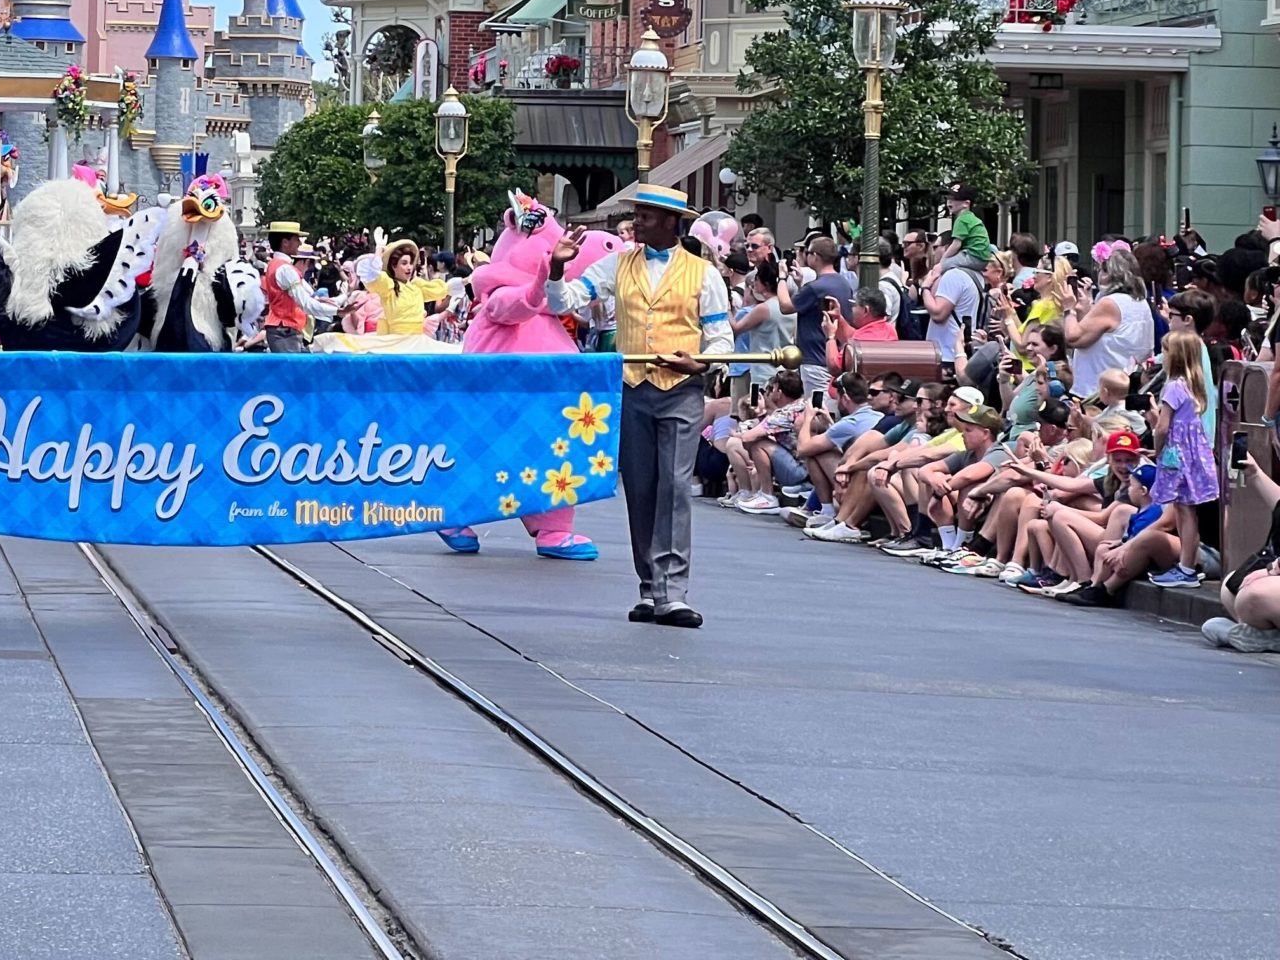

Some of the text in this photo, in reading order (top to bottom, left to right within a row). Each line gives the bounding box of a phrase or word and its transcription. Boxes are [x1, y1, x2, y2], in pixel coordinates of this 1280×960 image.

[579, 6, 617, 19] COFFEE
[222, 393, 456, 486] Easter
[228, 500, 445, 527] from the Magic Kingdom
